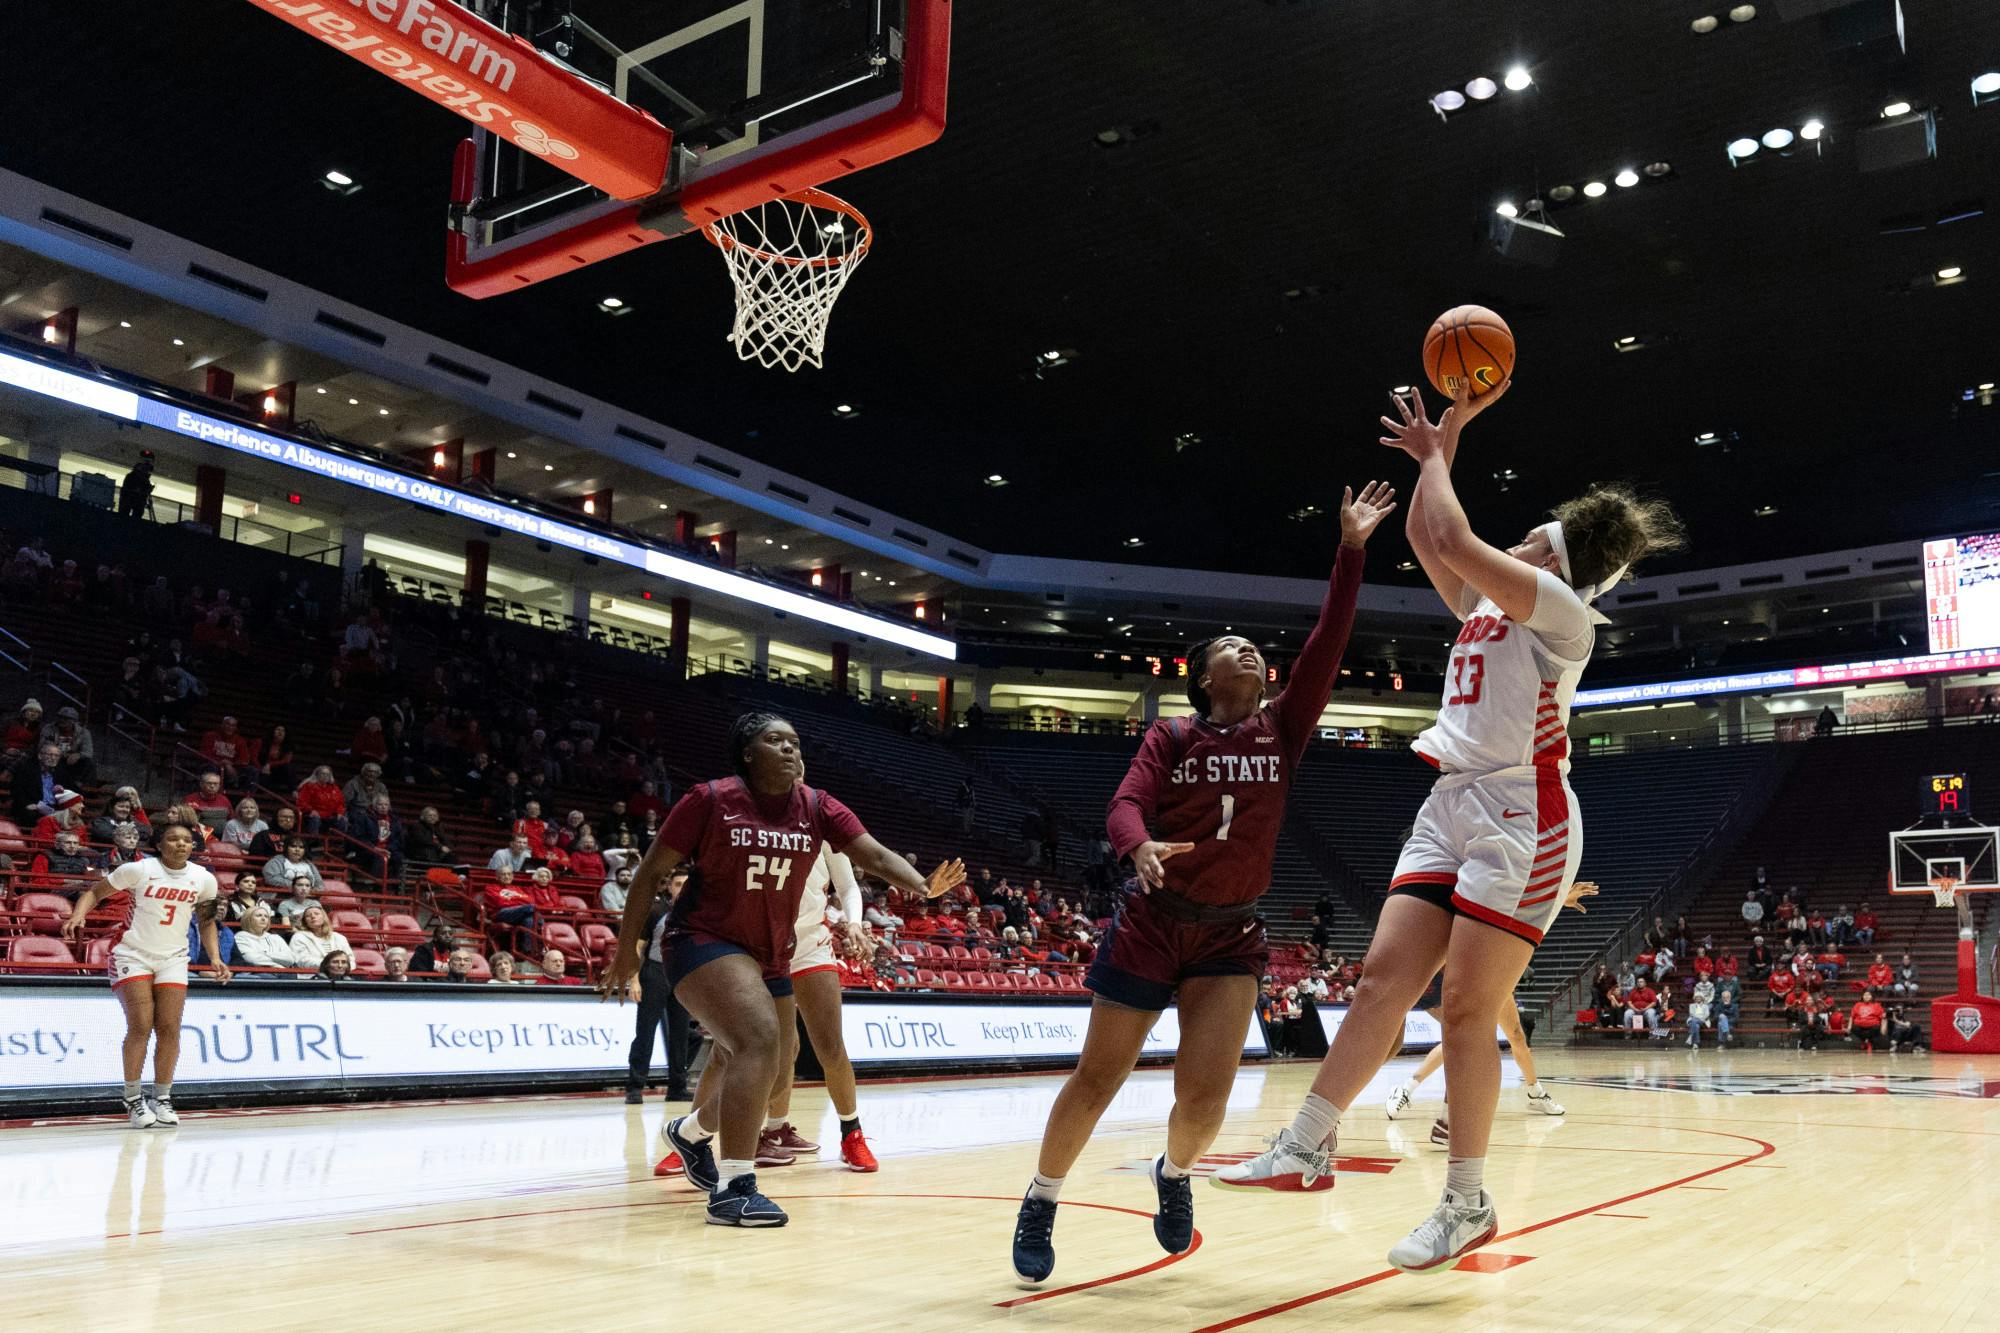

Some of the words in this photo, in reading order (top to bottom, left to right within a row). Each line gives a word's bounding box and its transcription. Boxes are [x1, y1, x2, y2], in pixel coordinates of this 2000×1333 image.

[264, 0, 513, 122] StateFar
[177, 412, 281, 458] Experience
[283, 445, 407, 494] Albuquerque's
[410, 482, 455, 507] ONLY
[456, 497, 538, 533] resort-style
[540, 520, 585, 547] fitness
[1455, 613, 1514, 645] BOS
[1152, 662, 1161, 675] 2
[1178, 663, 1188, 677] 3
[1268, 668, 1278, 682] 3
[1448, 653, 1485, 706] 33
[1394, 677, 1403, 690] 0
[1642, 684, 1670, 697] ONLY
[1171, 757, 1198, 784] SC
[1206, 755, 1280, 783] STATE
[1940, 790, 1958, 812] 19
[1216, 794, 1235, 841] 1
[730, 828, 752, 847] SC
[758, 829, 812, 853] STATE
[746, 854, 793, 891] 24
[143, 885, 199, 904] LOBOS
[159, 904, 177, 926] 3
[0, 1027, 84, 1063] sty.
[426, 1023, 504, 1053] Keep
[510, 1023, 535, 1047] It
[539, 1023, 620, 1051] Tasty.
[980, 1021, 1020, 1044] Keep
[1020, 1021, 1033, 1040] It
[1033, 1021, 1078, 1043] Tasty.
